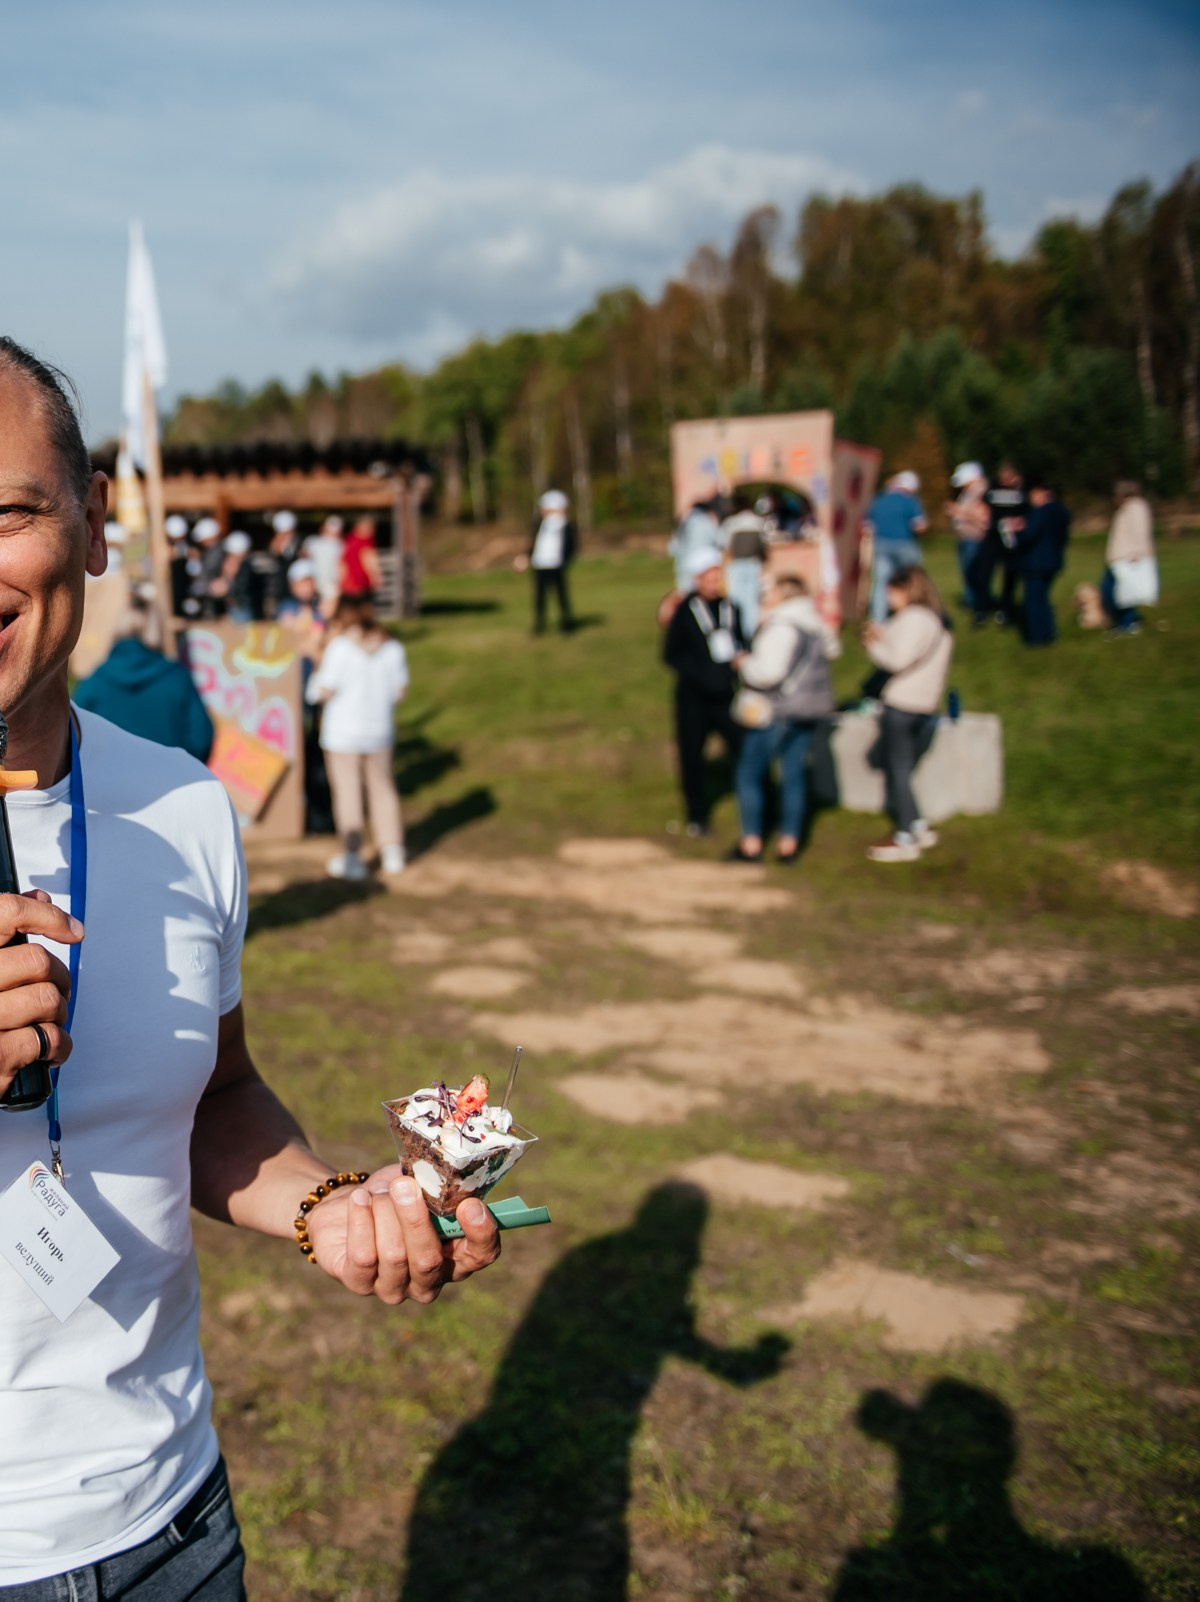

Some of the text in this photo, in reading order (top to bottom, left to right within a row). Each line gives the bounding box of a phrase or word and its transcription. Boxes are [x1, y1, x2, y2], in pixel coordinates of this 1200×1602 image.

[35, 1180, 66, 1217] Радуга
[37, 1226, 64, 1262] Игорь
[15, 1242, 55, 1286] ведущий
